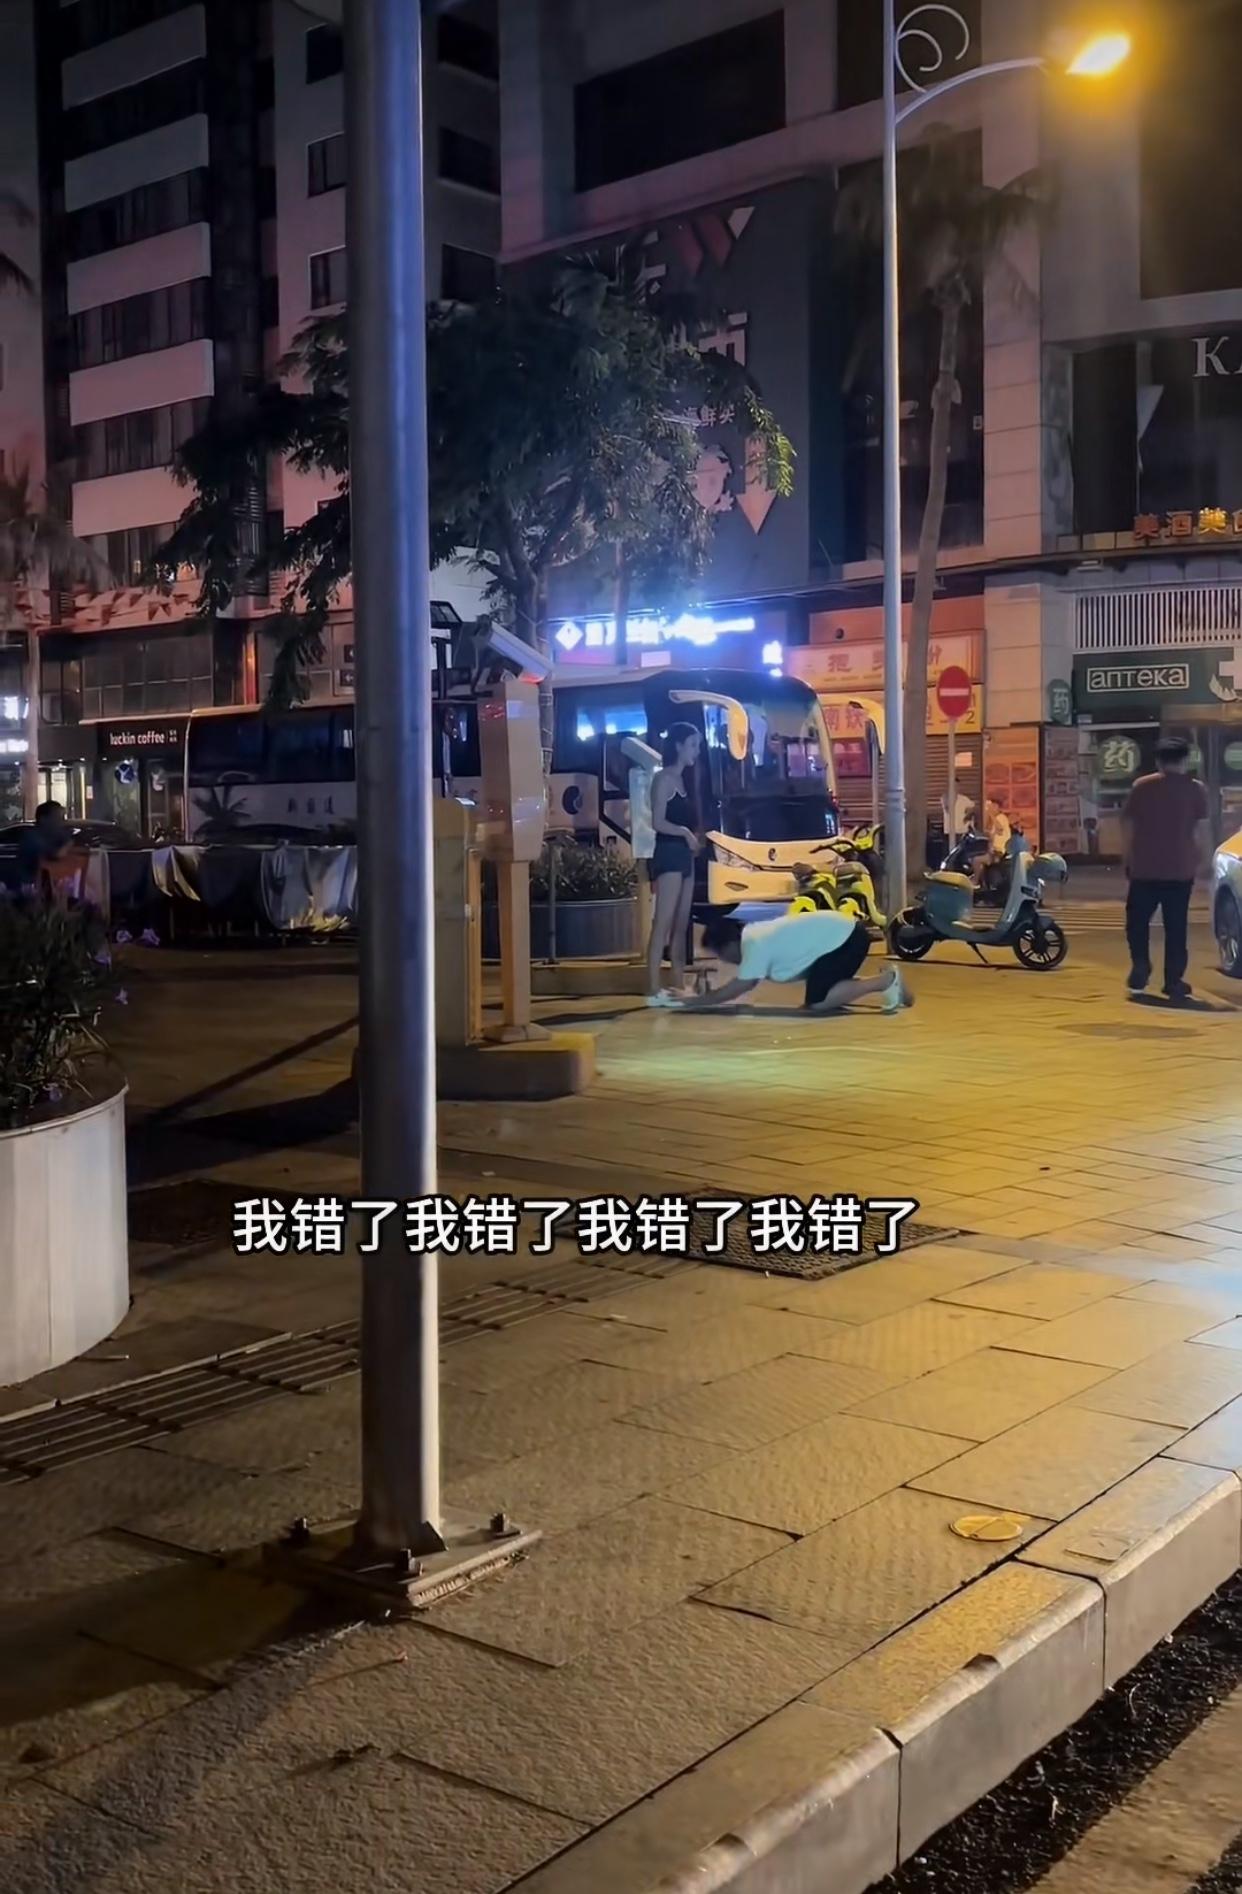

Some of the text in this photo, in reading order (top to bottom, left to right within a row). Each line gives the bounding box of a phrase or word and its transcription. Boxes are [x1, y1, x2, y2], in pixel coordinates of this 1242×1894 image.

[1191, 336, 1242, 377] K
[1091, 667, 1186, 689] аптека
[110, 731, 136, 746] luckin
[137, 730, 165, 744] coffee
[1103, 740, 1136, 773] 药
